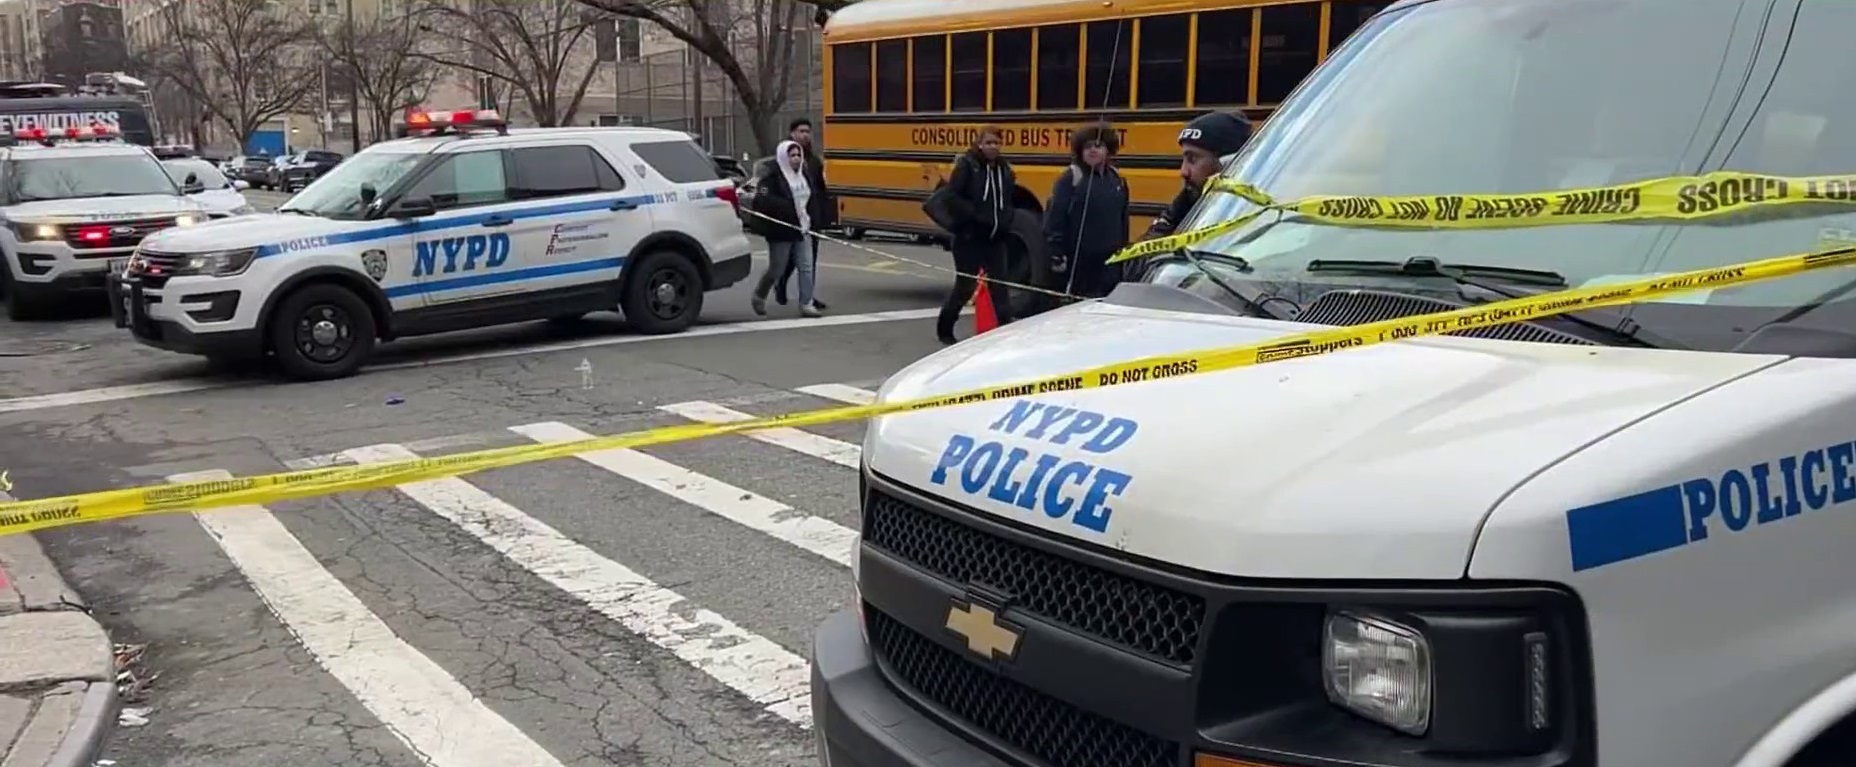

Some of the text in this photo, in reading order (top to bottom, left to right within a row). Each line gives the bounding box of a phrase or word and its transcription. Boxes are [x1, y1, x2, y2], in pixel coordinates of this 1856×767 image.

[0, 111, 119, 135] EYEWITNESS
[912, 127, 1015, 147] CONSOLIDED
[1020, 128, 1051, 147] BUS
[1319, 197, 1383, 219] CROSS
[1434, 196, 1463, 221] DO
[1465, 197, 1548, 219] SCENE
[1551, 187, 1641, 216] CRIME
[1677, 178, 1787, 214] CROSS
[1386, 199, 1430, 220] NOT
[281, 236, 327, 254] POLICE
[412, 233, 510, 277] NYPD
[1099, 371, 1118, 387] DO
[1121, 366, 1149, 384] NOT
[1152, 359, 1198, 379] CROSS
[989, 400, 1138, 454] NYPD
[930, 434, 1133, 533] POLICE
[1683, 441, 1856, 543] POLICE
